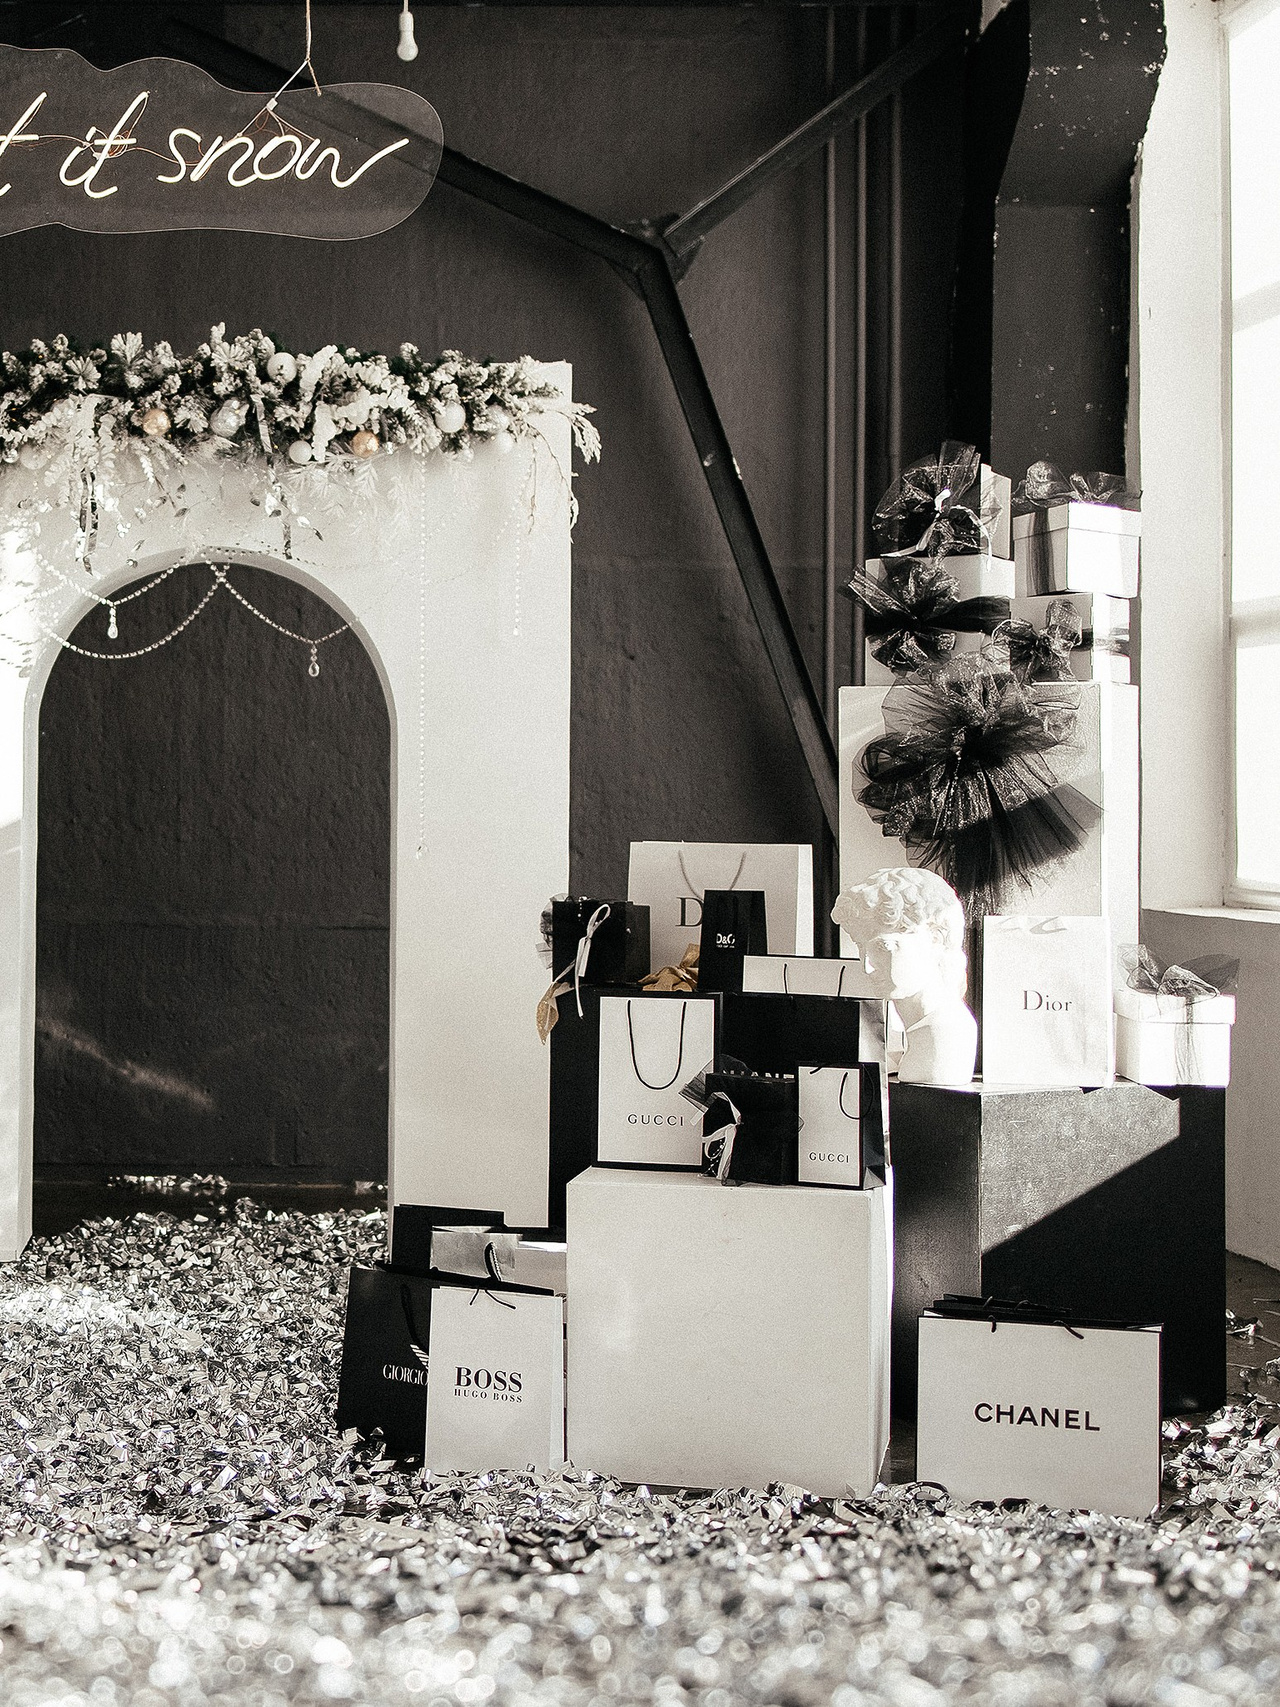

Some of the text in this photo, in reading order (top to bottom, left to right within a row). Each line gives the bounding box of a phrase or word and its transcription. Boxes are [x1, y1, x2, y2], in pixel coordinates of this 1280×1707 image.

[58, 90, 148, 199] it
[156, 127, 411, 188] snow
[1022, 989, 1073, 1012] Dior
[627, 1113, 684, 1127] GUCCI
[808, 1151, 850, 1164] GUCCI
[382, 1363, 428, 1386] GIORGIO
[454, 1365, 523, 1393] BOSS
[453, 1388, 523, 1404] HUGO BOSS
[974, 1402, 1101, 1432] CHANEL
